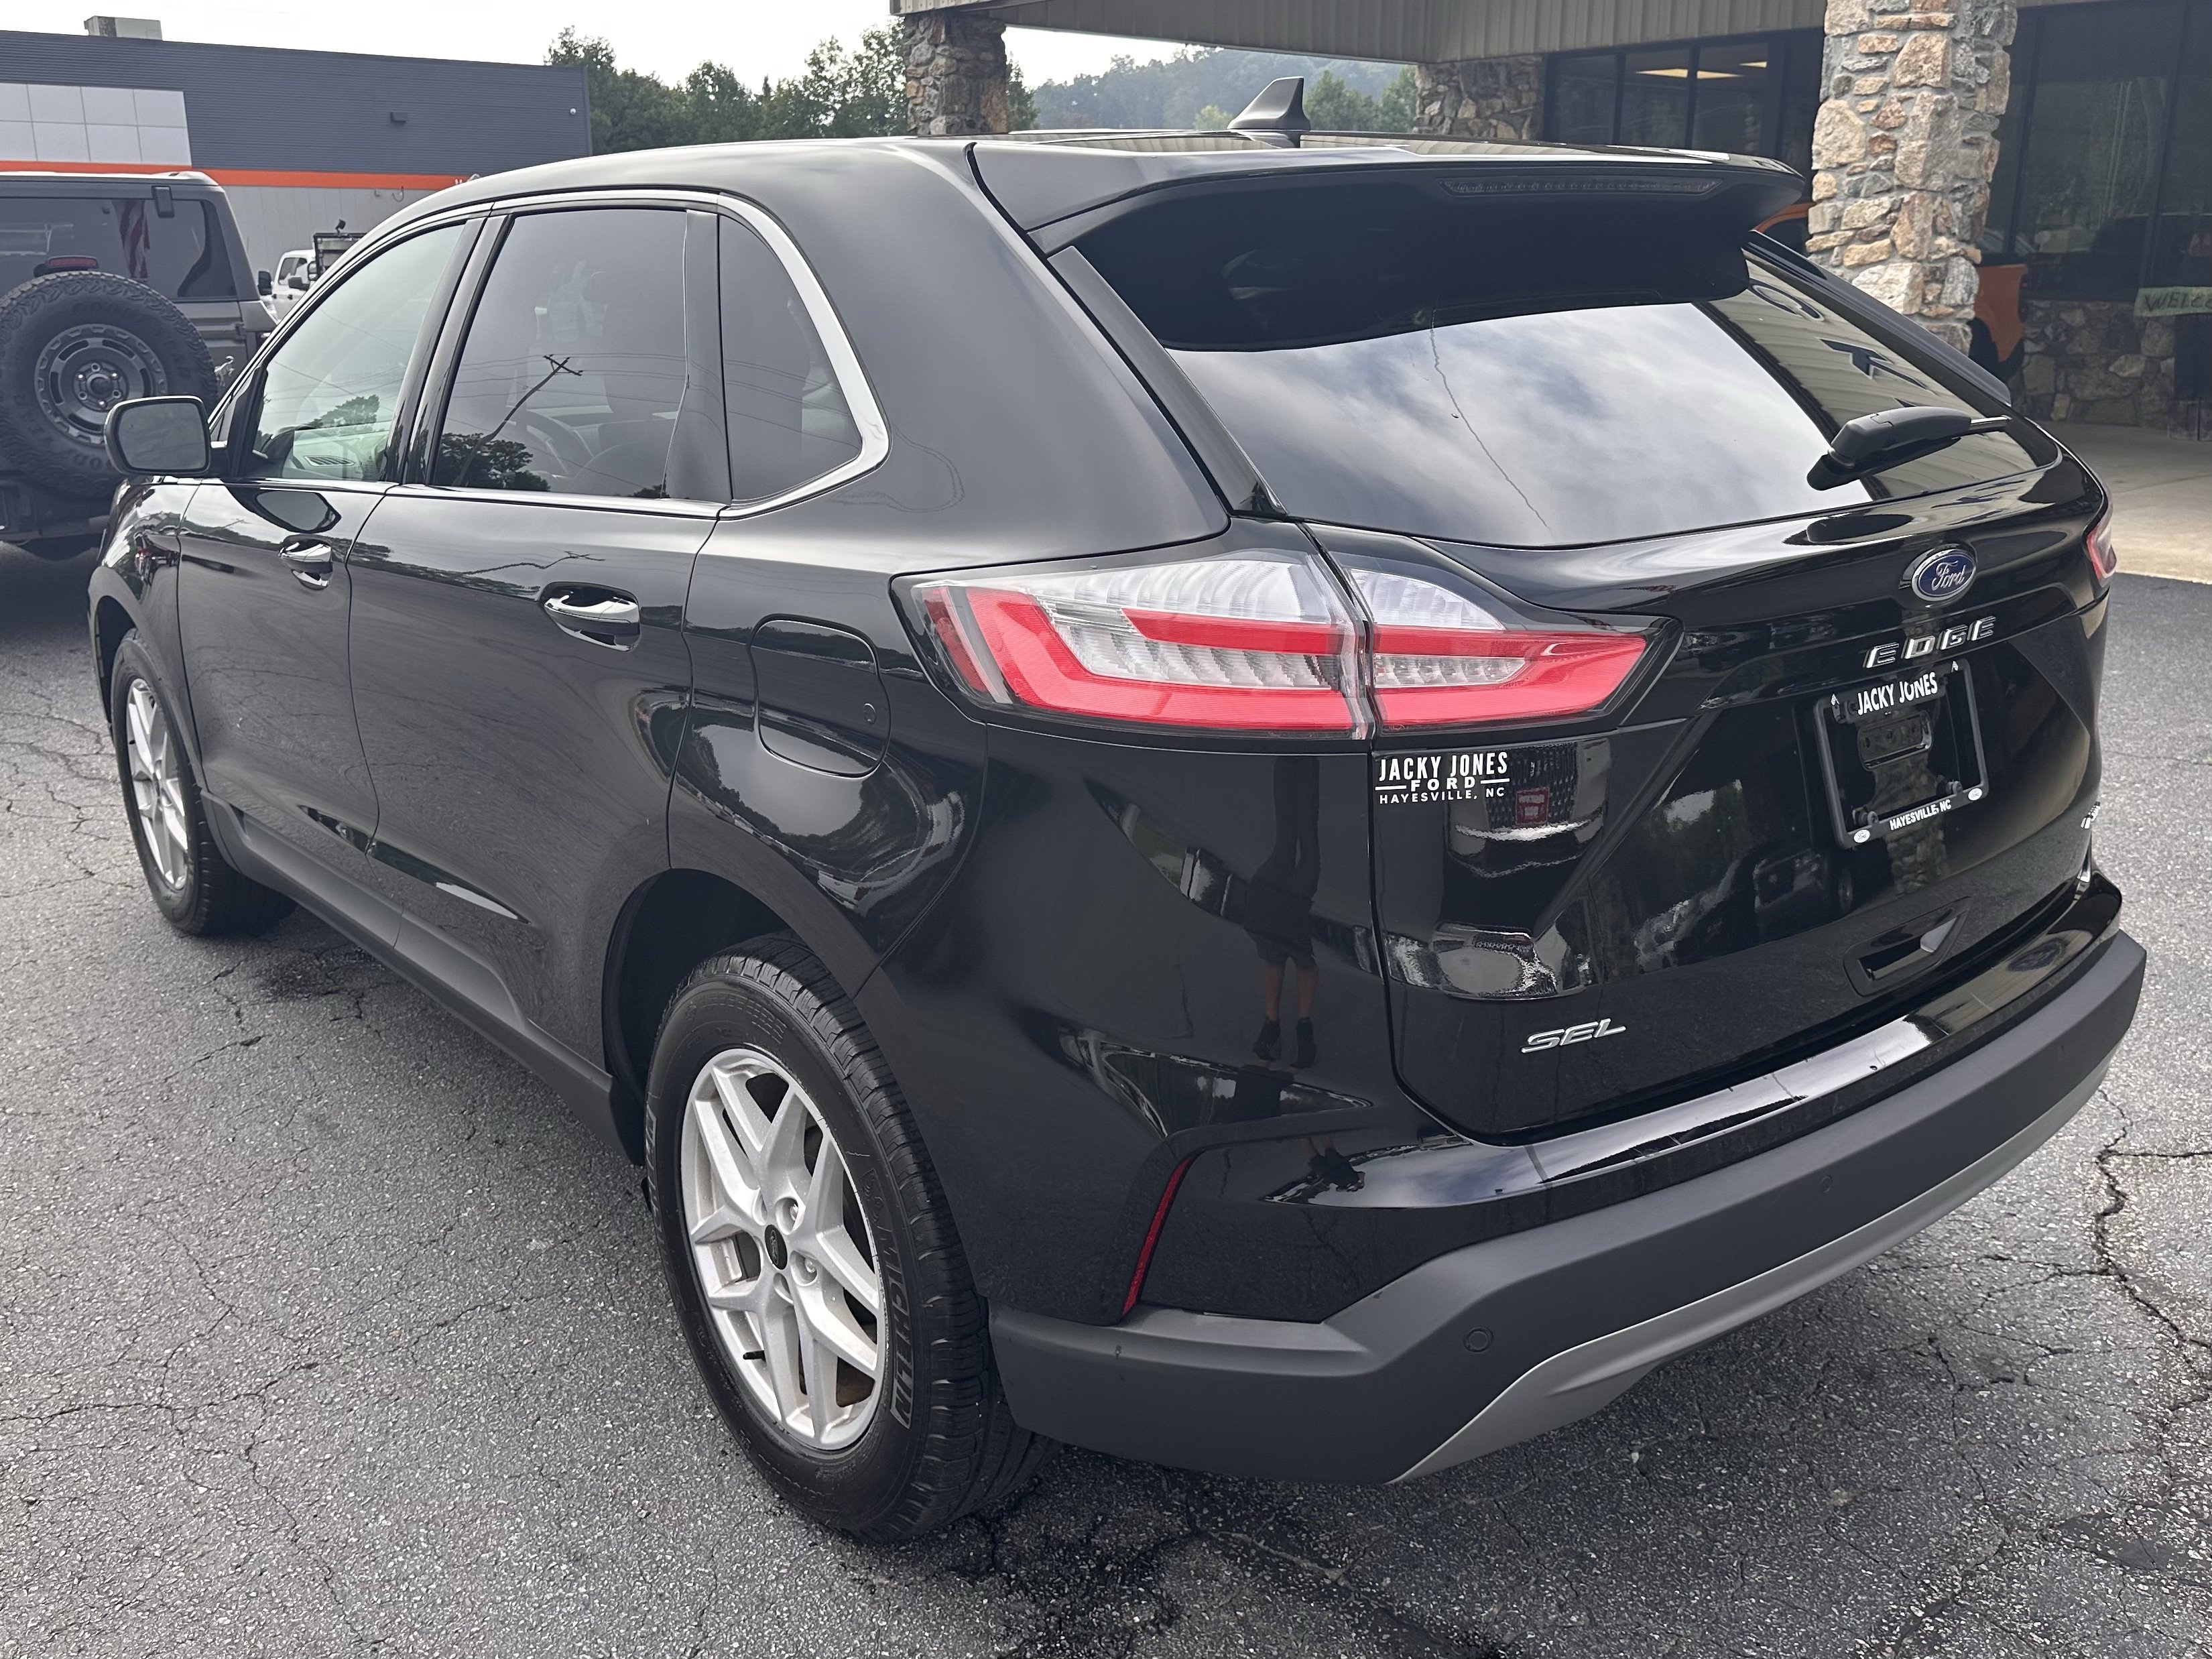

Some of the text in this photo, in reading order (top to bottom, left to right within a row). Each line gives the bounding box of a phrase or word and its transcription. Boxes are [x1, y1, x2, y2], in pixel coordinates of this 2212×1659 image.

[1931, 560, 1966, 591] Ford
[1863, 615, 1996, 668] EDGE
[1857, 672, 1938, 715] JACKY JONES
[1379, 751, 1508, 782] JACKY JONES
[1379, 787, 1505, 804] HAYESVILLE, NC
[1410, 779, 1475, 792] FORD
[1889, 799, 1951, 831] HAYESVILLE, NC
[1520, 1018, 1626, 1053] SEL
